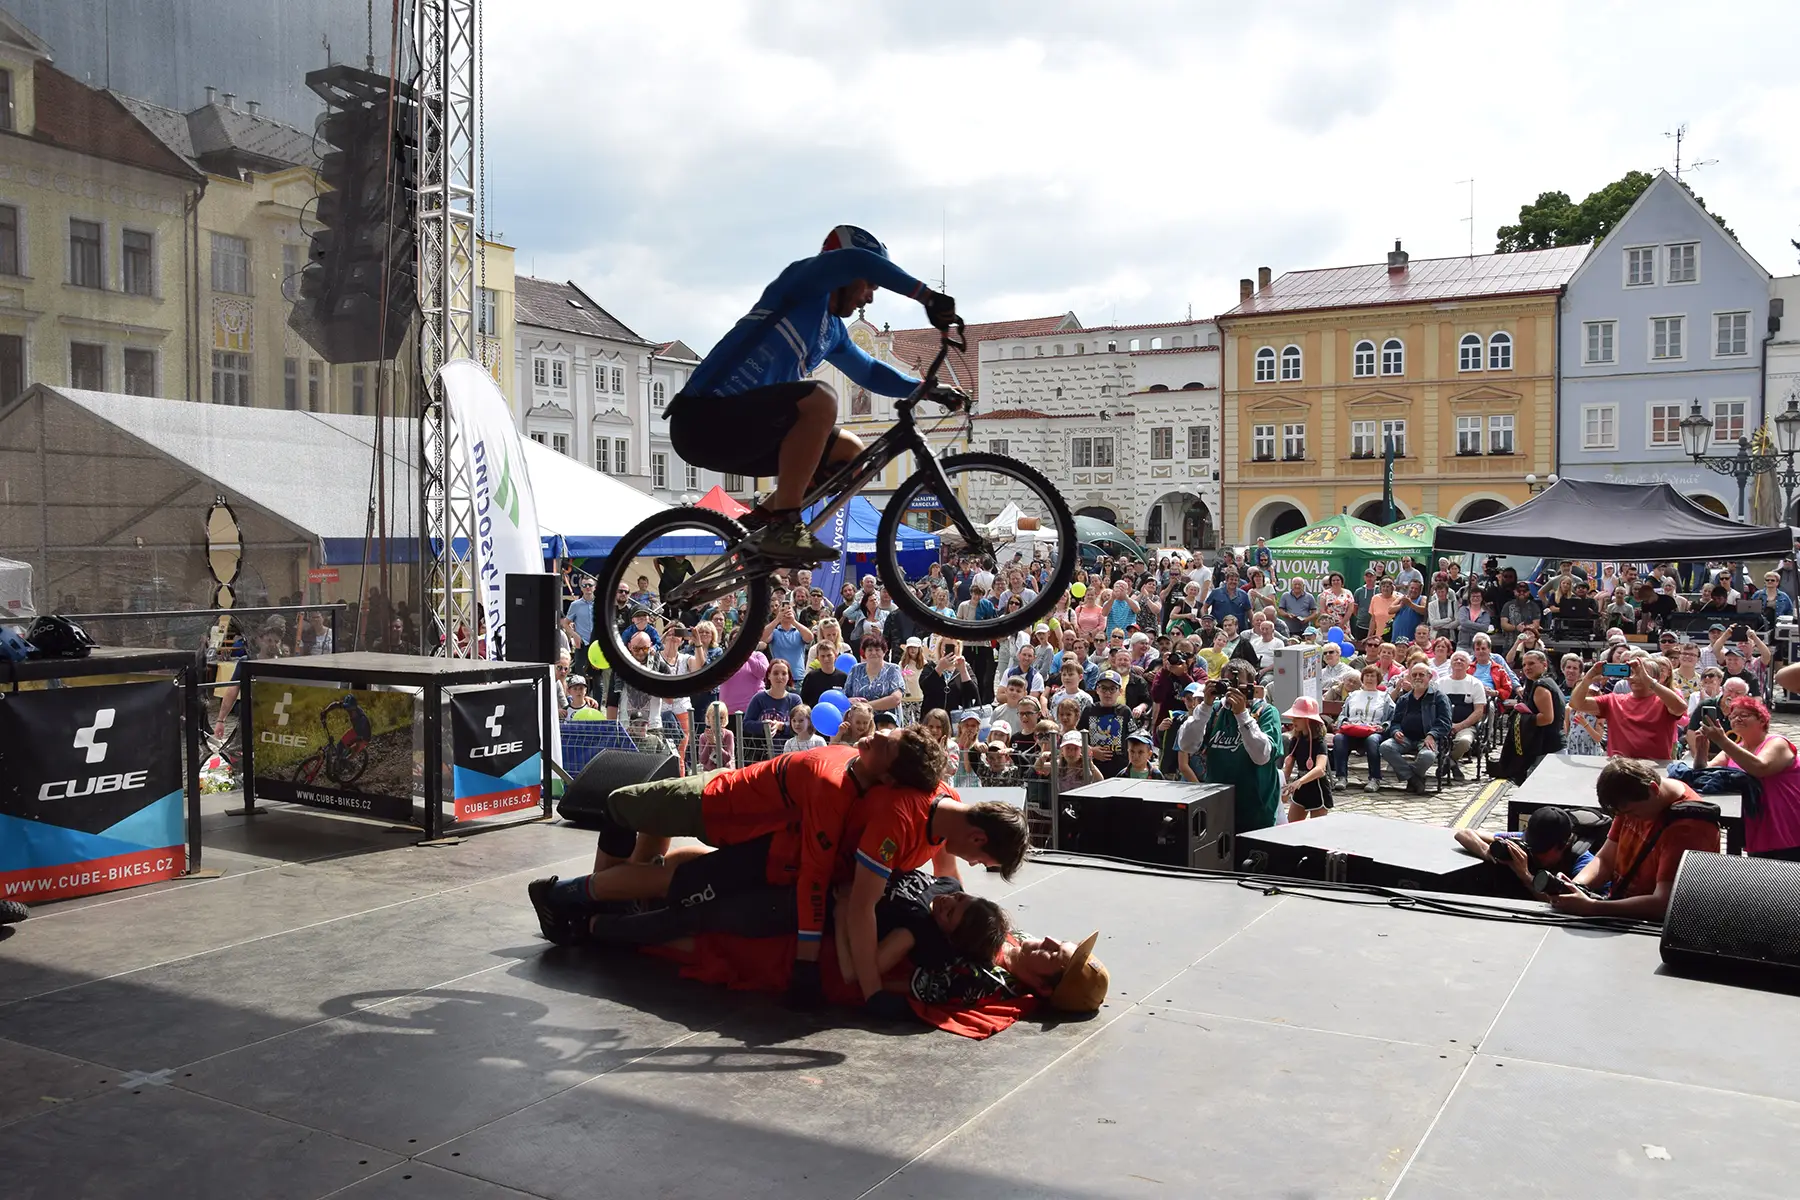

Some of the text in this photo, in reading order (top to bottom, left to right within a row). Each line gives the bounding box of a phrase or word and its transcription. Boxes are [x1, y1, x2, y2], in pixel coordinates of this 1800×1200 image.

[261, 731, 308, 748] CUBE
[469, 740, 523, 759] CUBE
[38, 770, 148, 801] CUBE
[296, 789, 371, 810] WWW.CUBE-BIKES.CZ
[464, 793, 531, 814] CUBE-BIKES.CZ
[5, 857, 174, 895] WWW.CUBE-BIKES.CZ
